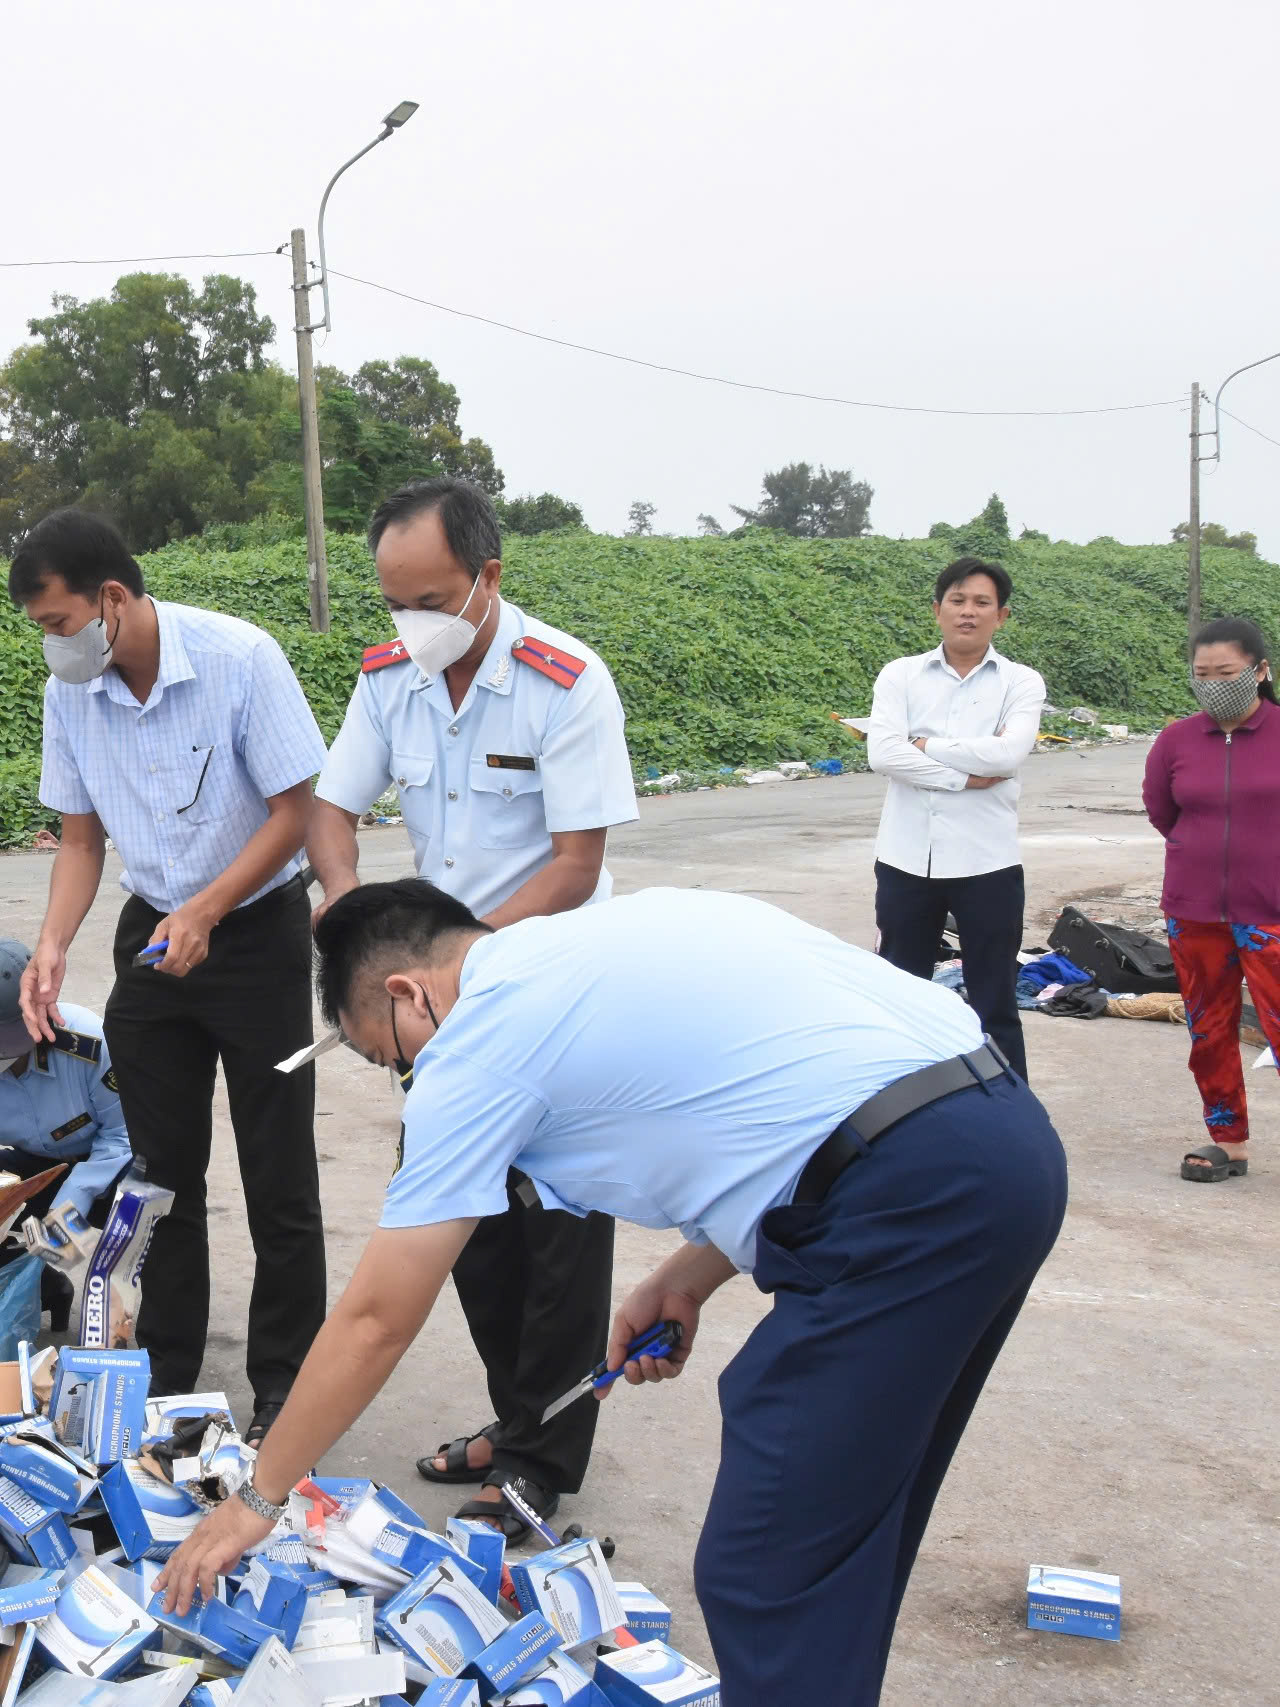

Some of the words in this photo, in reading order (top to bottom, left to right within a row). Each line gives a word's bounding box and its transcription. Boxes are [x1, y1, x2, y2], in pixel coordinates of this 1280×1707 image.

[85, 1275, 105, 1348] HERO
[115, 1374, 126, 1408] STANDS
[109, 1409, 122, 1462] MICROPHONE
[1, 1463, 24, 1479] STANDS
[25, 1473, 70, 1502] MICROPHONE
[641, 1621, 669, 1629] STANDS
[517, 1627, 555, 1668] MICROPHONE
[493, 1662, 516, 1684] STANDS
